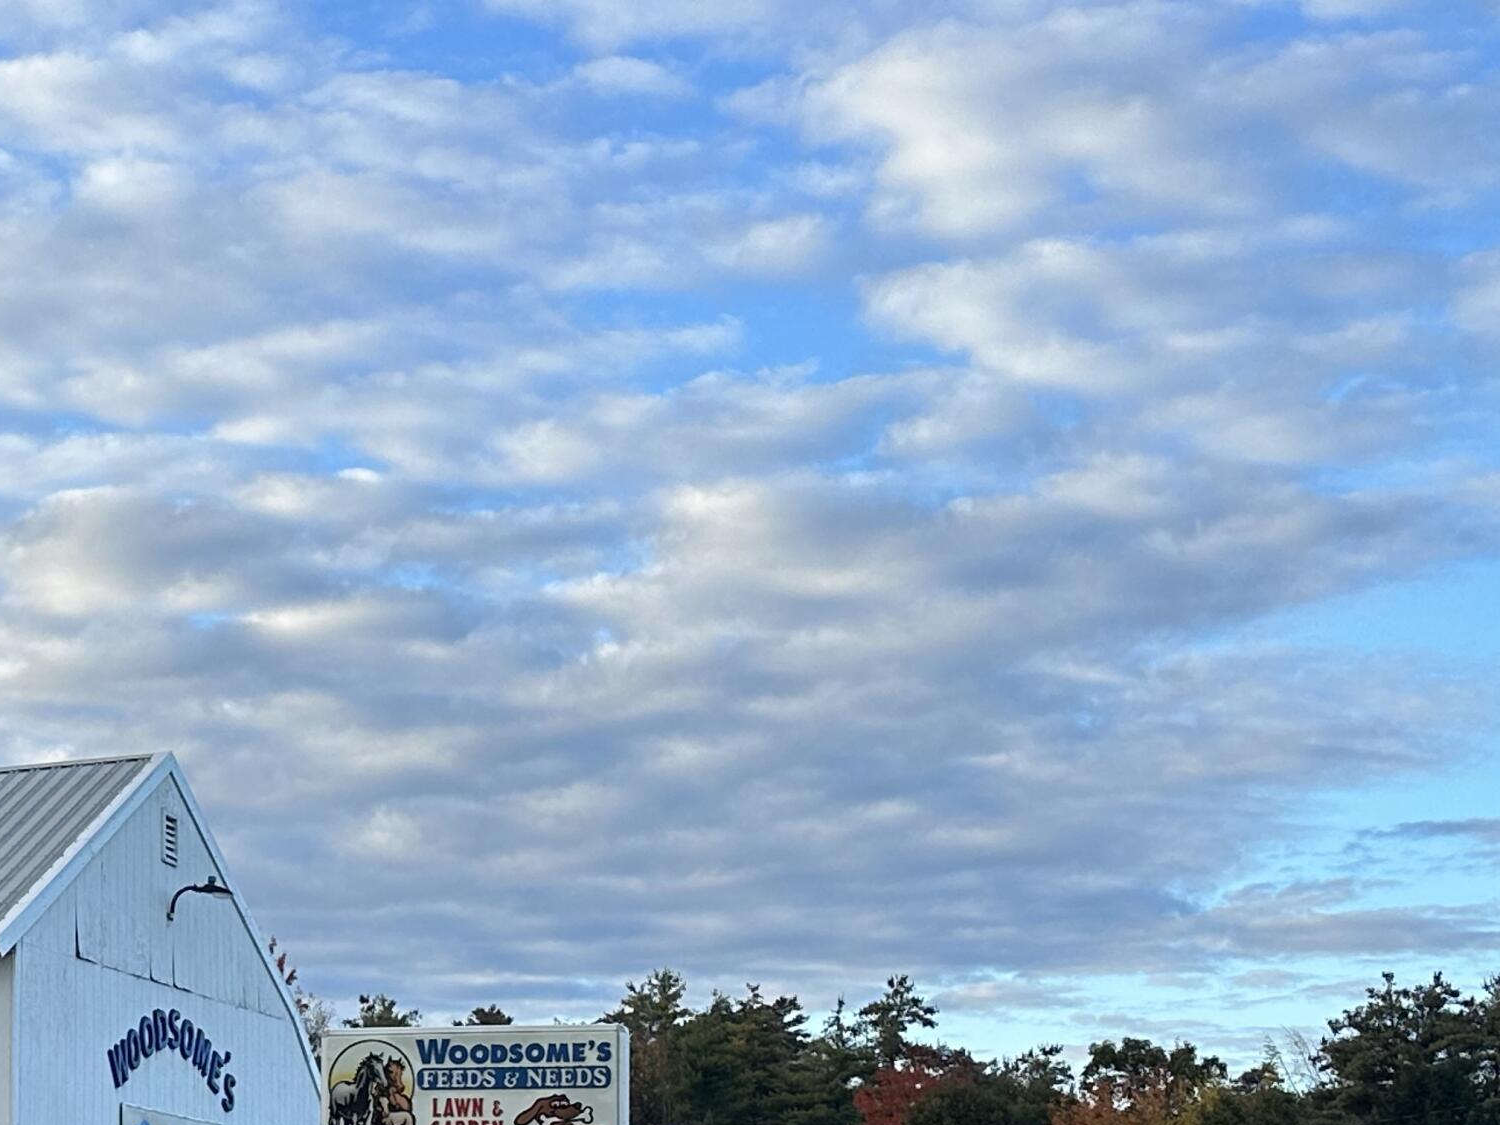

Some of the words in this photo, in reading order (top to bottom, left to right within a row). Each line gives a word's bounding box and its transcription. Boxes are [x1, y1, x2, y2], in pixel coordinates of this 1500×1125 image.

[107, 1008, 236, 1113] WOODSOME'S
[422, 1069, 496, 1088] FEEDS
[504, 1070, 519, 1088] &
[526, 1067, 607, 1087] NEEDS
[432, 1097, 484, 1118] LAWN
[492, 1100, 504, 1117] &
